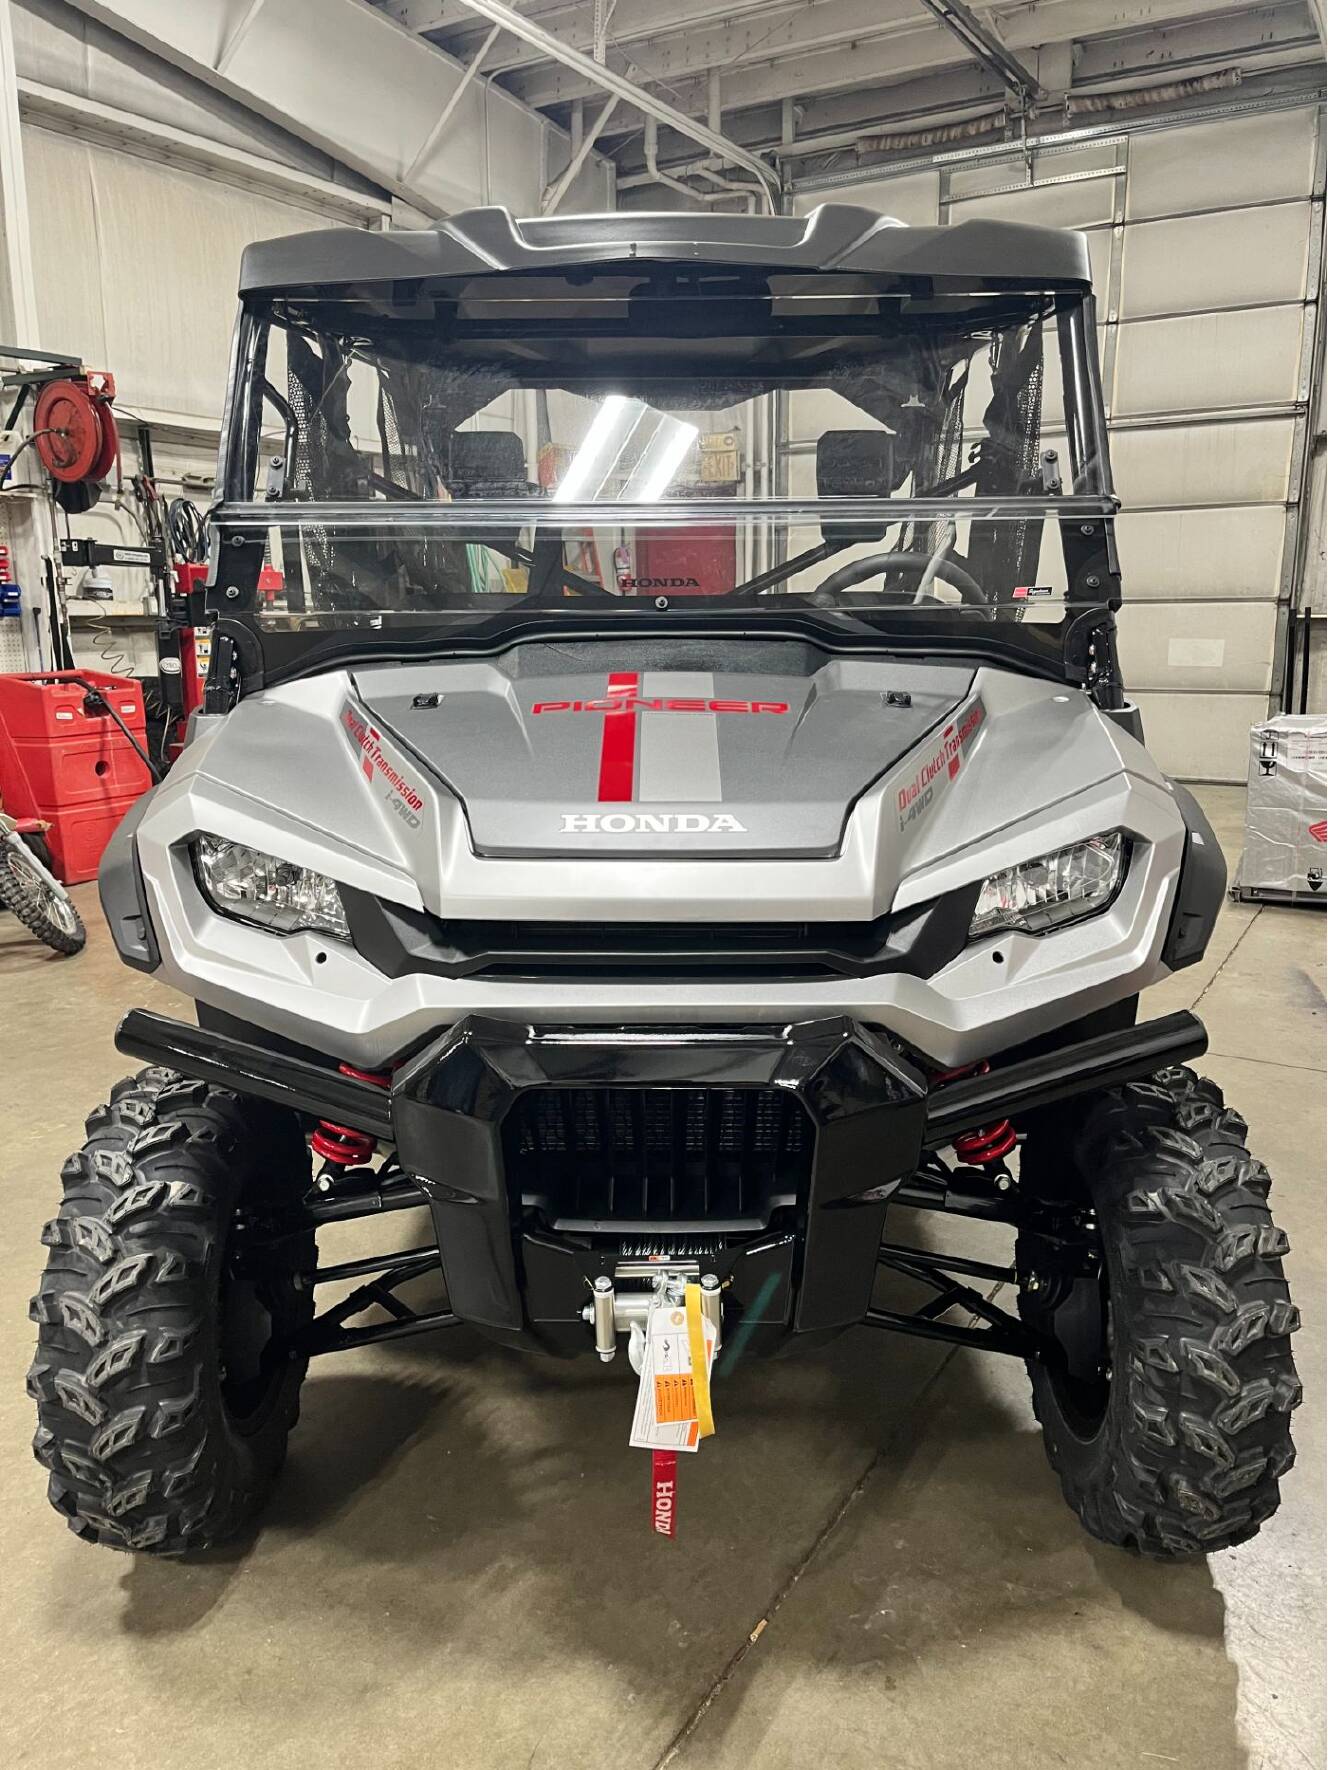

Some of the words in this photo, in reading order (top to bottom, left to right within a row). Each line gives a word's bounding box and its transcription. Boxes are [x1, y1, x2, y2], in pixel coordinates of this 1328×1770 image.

[620, 577, 700, 588] HONDA
[532, 698, 791, 715] PIONEER
[370, 746, 423, 811] Transmission
[898, 775, 920, 811] Dual
[921, 749, 946, 787] Clutch
[558, 813, 748, 834] HONDA
